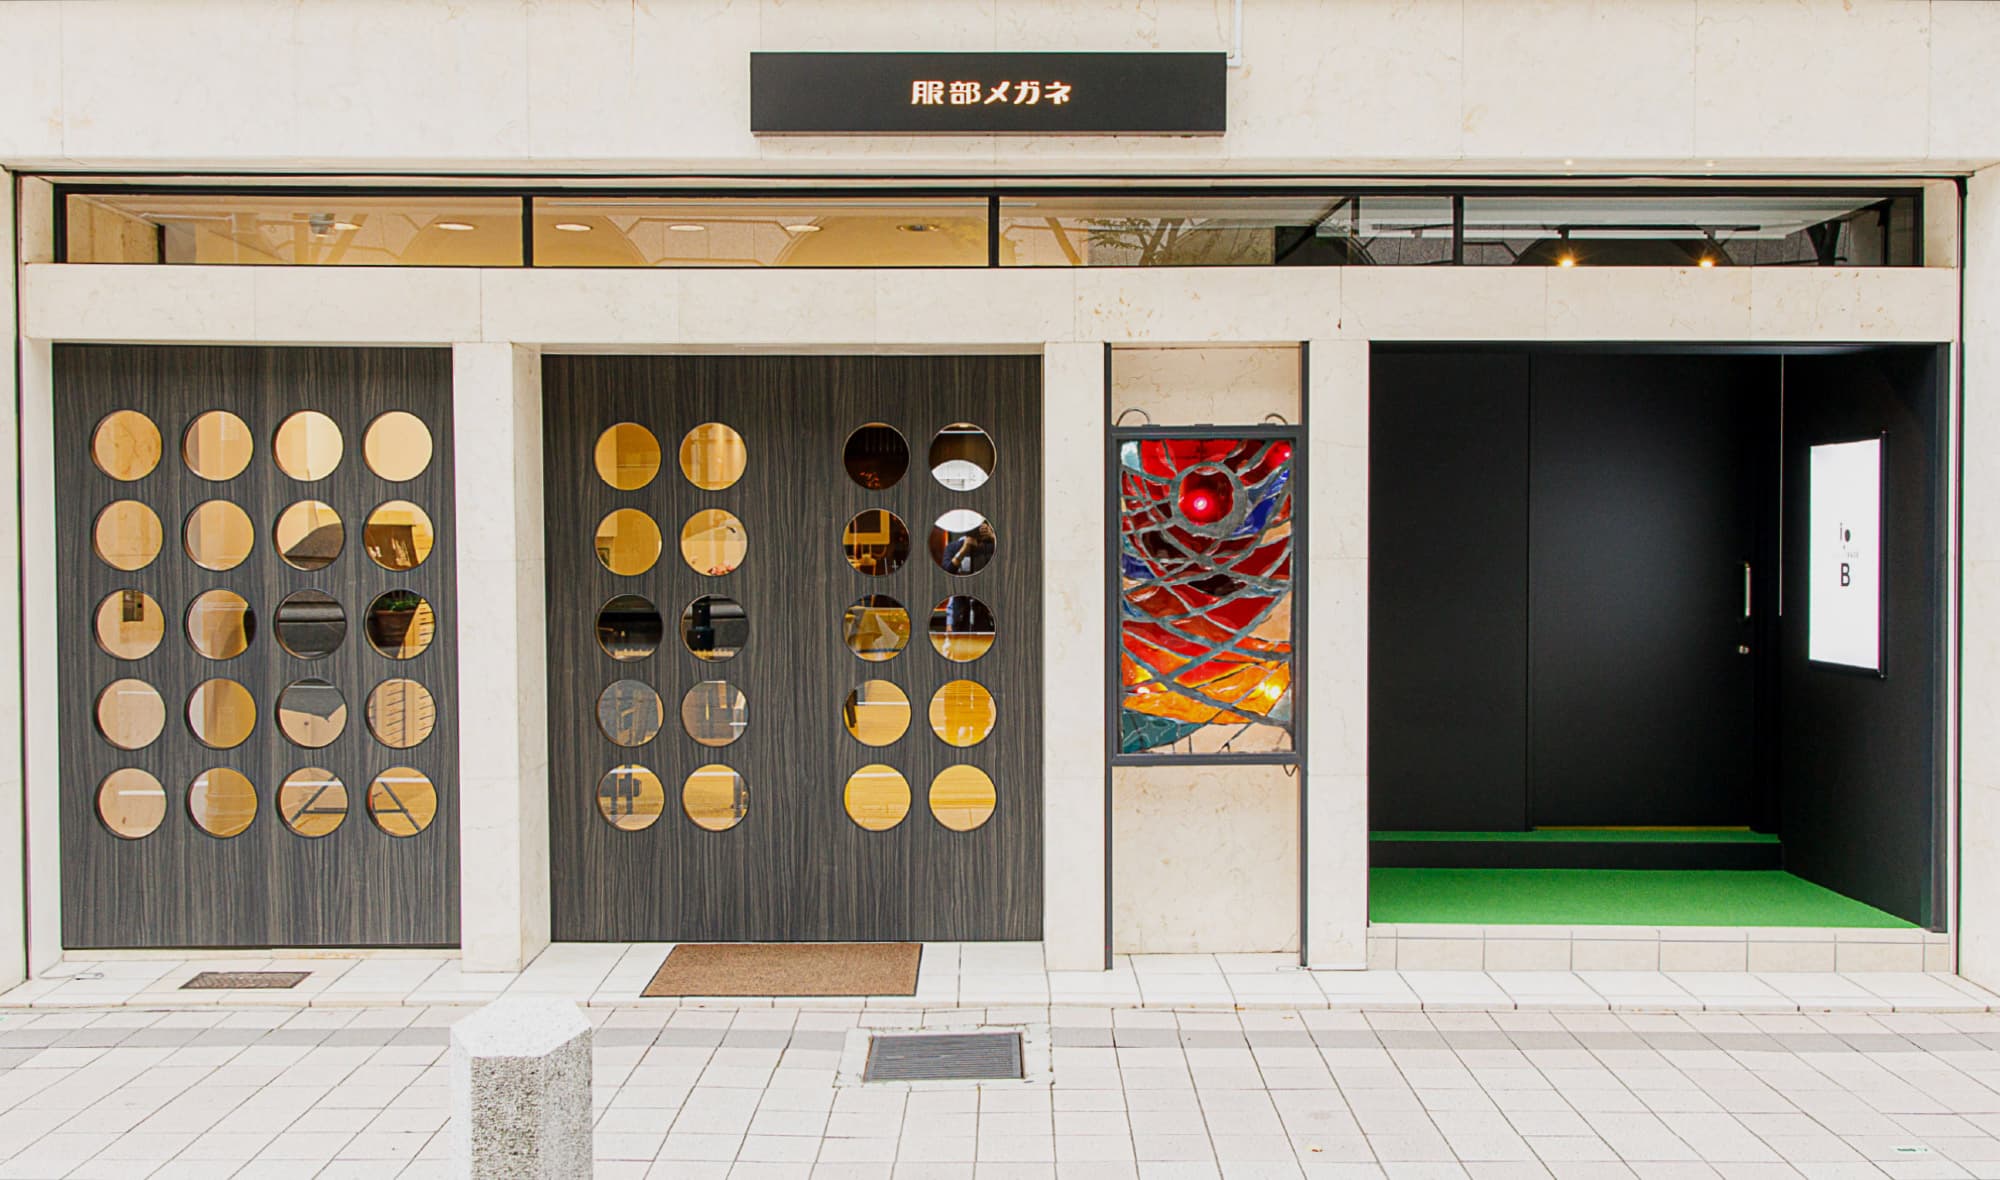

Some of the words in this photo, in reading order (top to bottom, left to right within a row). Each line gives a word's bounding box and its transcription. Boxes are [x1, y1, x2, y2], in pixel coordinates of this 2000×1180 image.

[911, 80, 1072, 105] 服部メガネ
[1840, 562, 1850, 587] B
